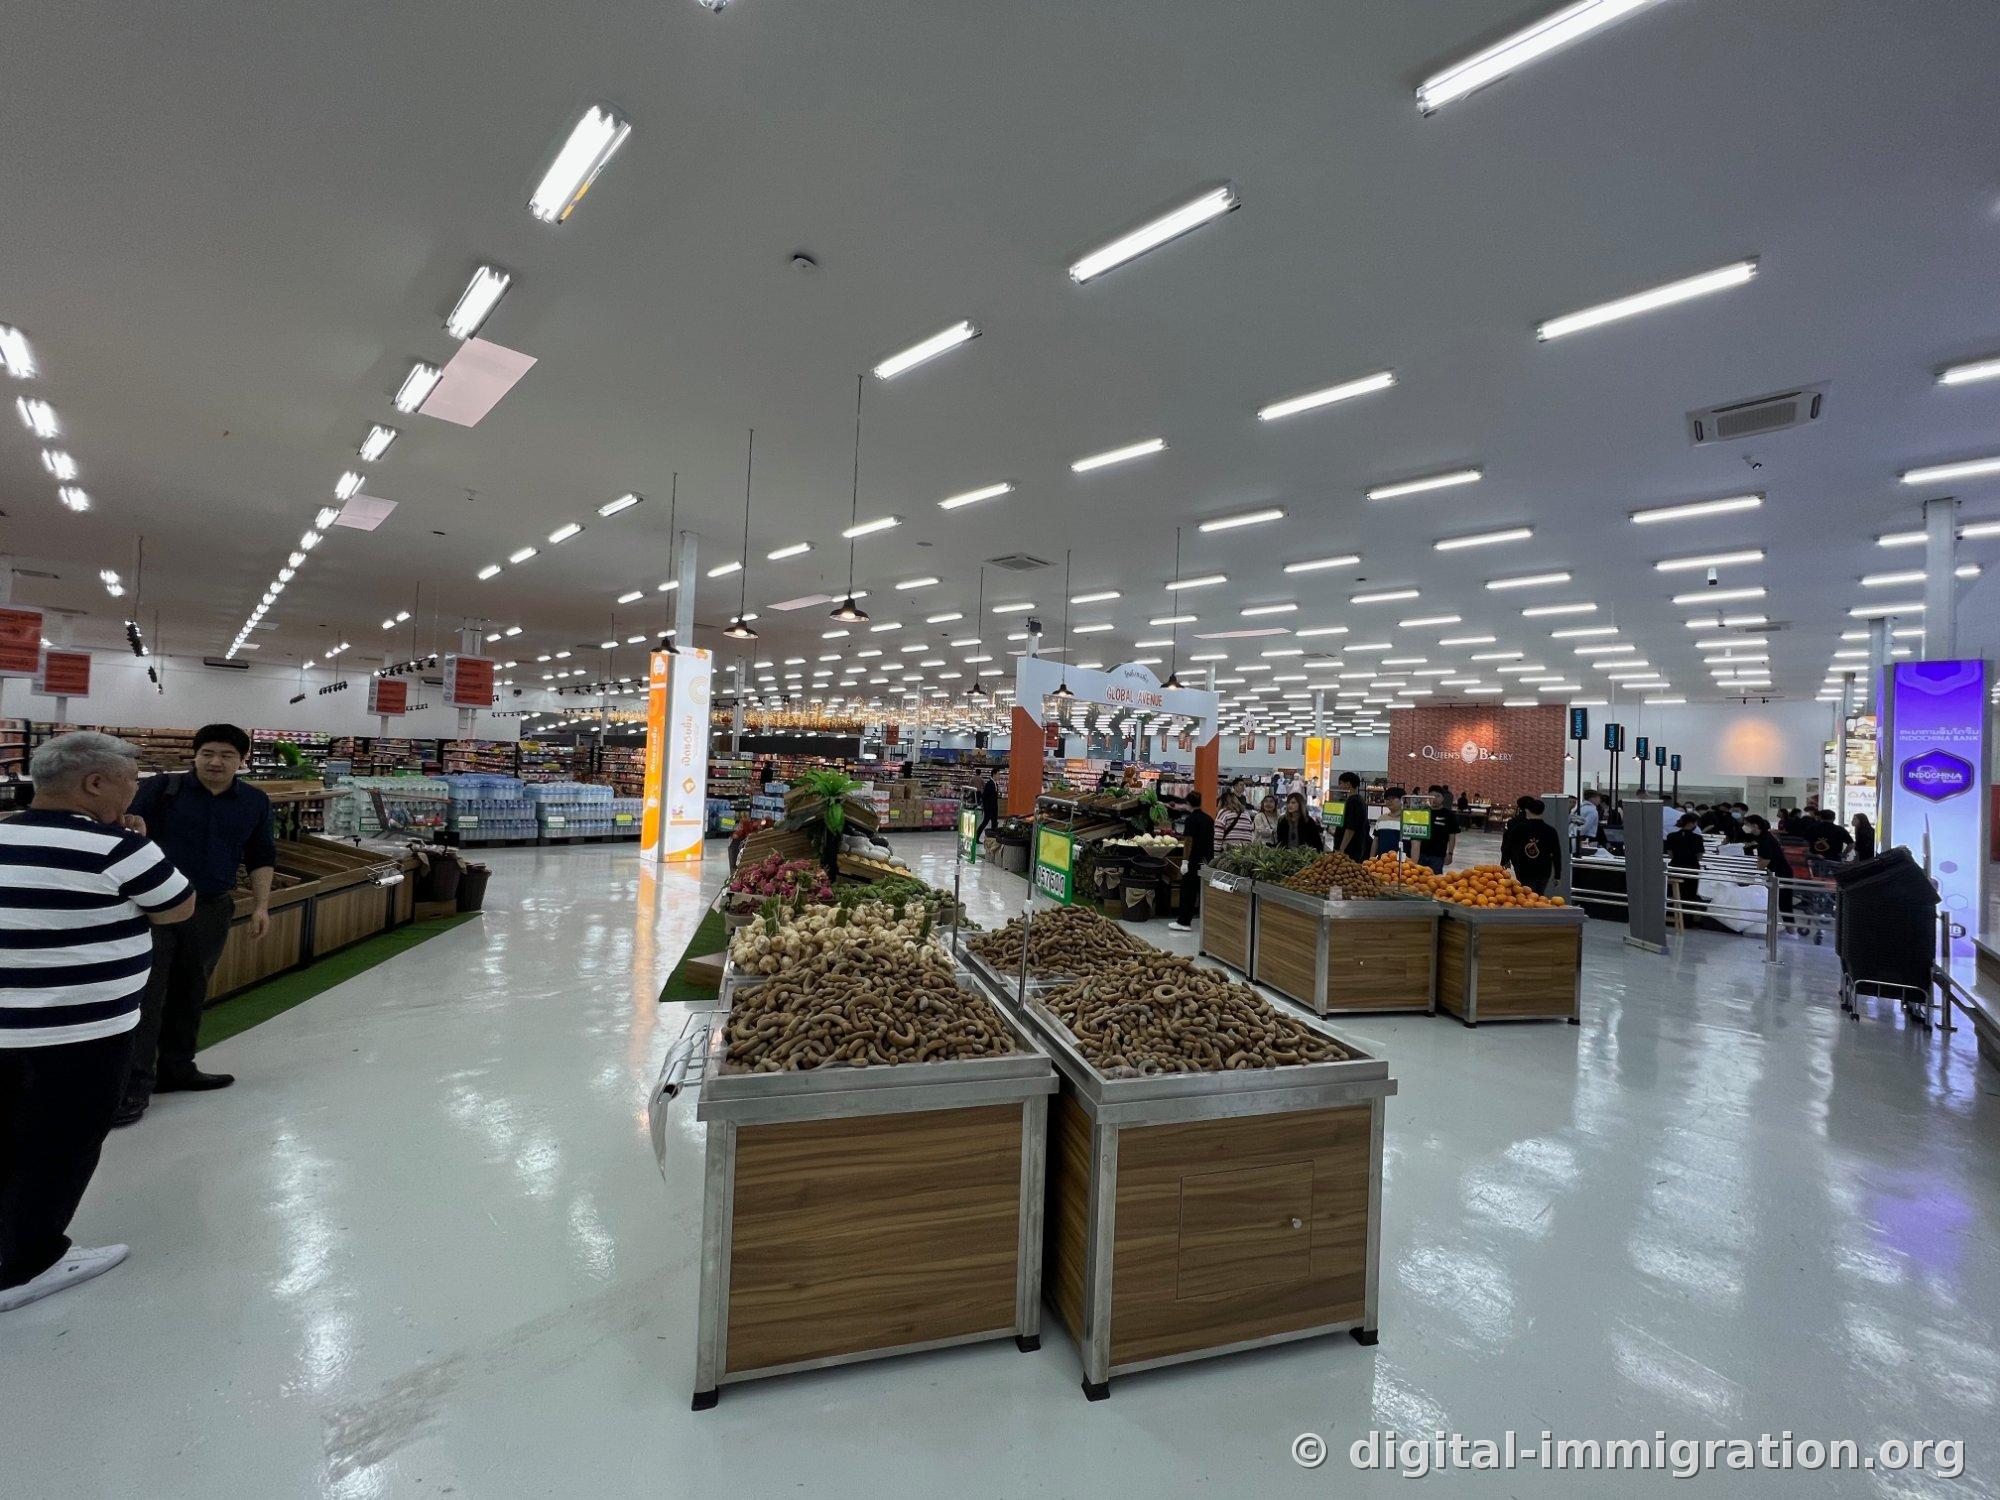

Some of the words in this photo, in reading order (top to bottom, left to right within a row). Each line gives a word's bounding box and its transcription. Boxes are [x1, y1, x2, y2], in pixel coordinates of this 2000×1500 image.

[1106, 686, 1133, 702] GLOBAL
[1137, 691, 1162, 707] AVENUE
[1479, 747, 1513, 760] BERY
[1909, 771, 1962, 781] INDOCHINA
